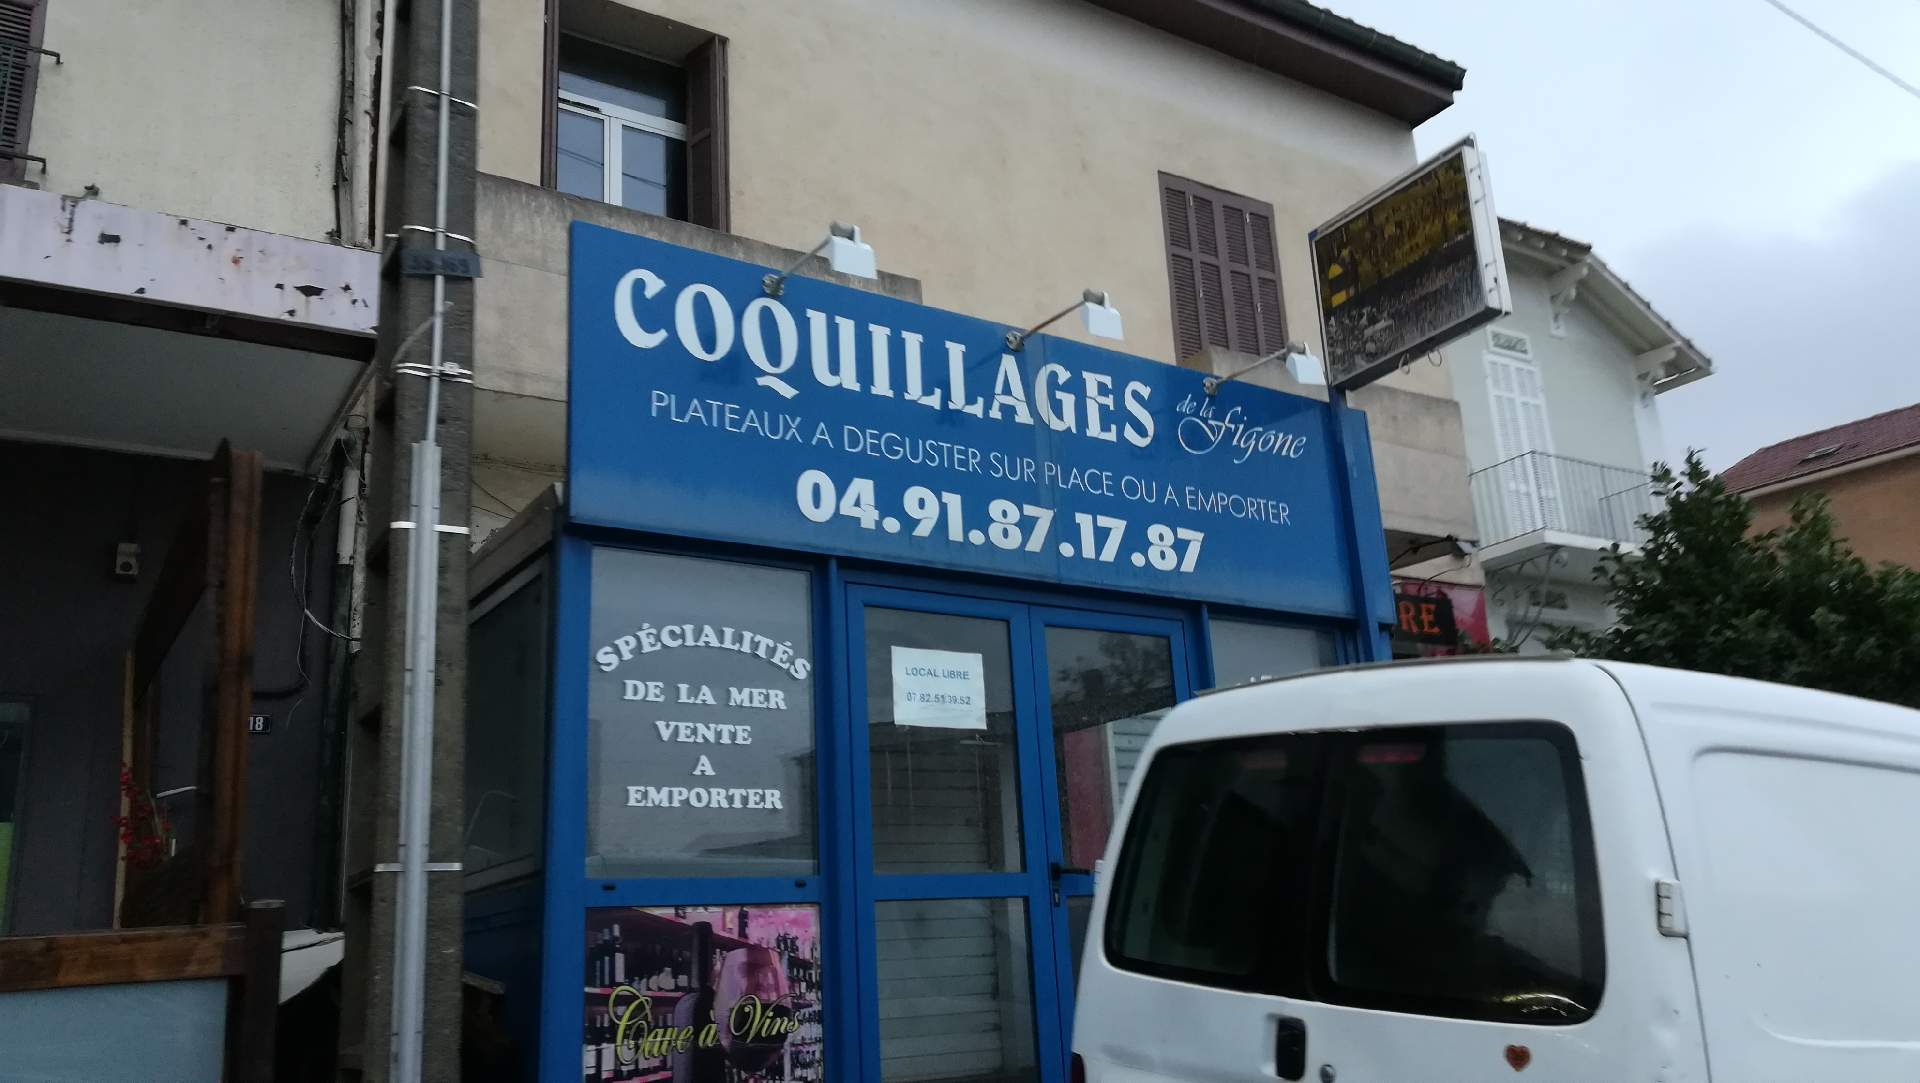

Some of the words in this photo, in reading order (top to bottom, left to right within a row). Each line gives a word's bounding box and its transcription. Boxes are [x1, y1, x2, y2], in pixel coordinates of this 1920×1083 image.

[614, 268, 1155, 447] COQUILLAGES
[1176, 393, 1197, 415] de
[1199, 397, 1216, 418] la
[1178, 406, 1307, 464] Figone
[651, 390, 803, 443] PLATEAUX
[811, 422, 834, 449] A
[843, 425, 982, 474] DEGUSTER
[989, 452, 1036, 483] SUR
[1045, 461, 1114, 497] PLACE
[1121, 475, 1156, 503] OU
[1164, 484, 1180, 508] A
[1186, 486, 1291, 526] EMPORTER
[796, 469, 1205, 573] 04.91.87.17.87
[595, 623, 812, 680] SPÉCIALITÉS
[905, 667, 940, 678] LOCAL
[942, 669, 970, 680] LIBRE
[623, 679, 666, 702] DE
[677, 683, 718, 705] LA
[728, 687, 788, 710] MER
[906, 691, 971, 706] 0782.51.39.52
[655, 720, 752, 745] VENTE
[692, 755, 716, 776] A
[626, 786, 784, 810] EMPORTER
[608, 985, 694, 1065] Cave
[698, 1009, 719, 1048] à
[729, 993, 800, 1044] Vins
